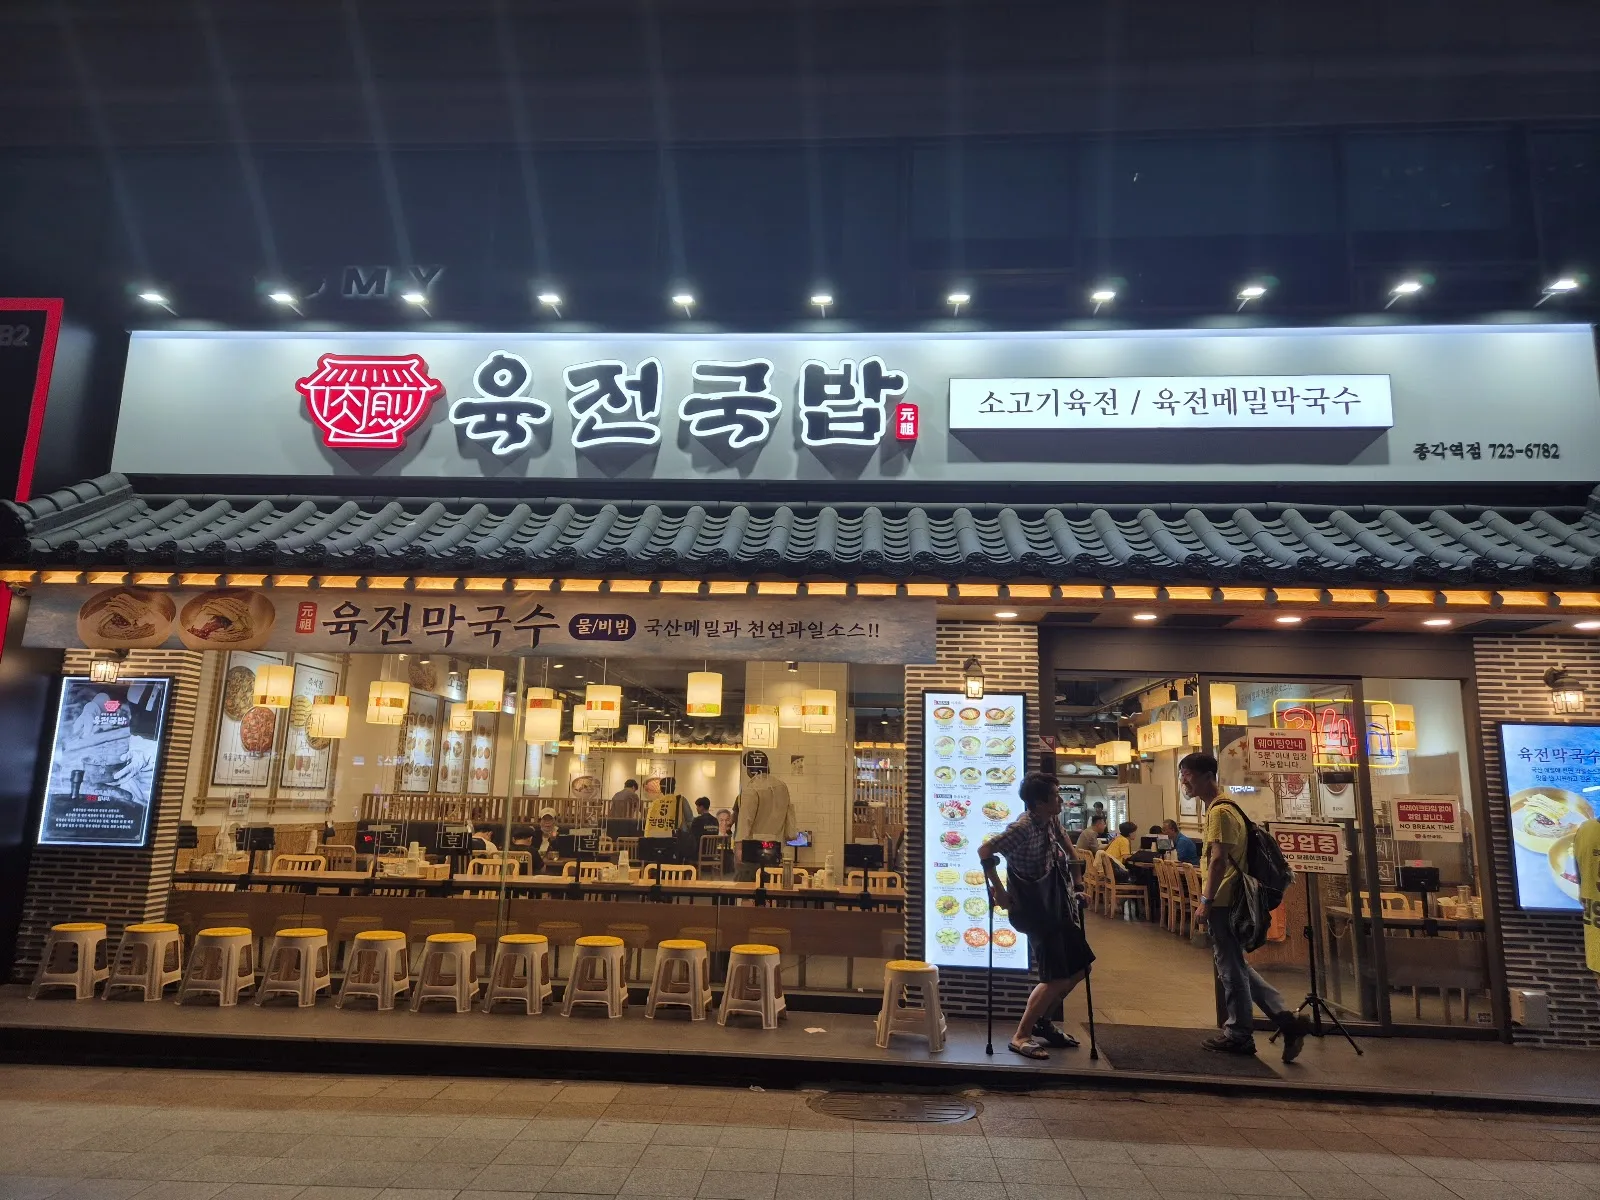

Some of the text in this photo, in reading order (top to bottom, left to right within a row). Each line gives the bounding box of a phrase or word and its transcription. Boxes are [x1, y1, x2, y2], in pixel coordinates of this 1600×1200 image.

[450, 350, 907, 454] 육전국밥
[977, 388, 1120, 417] 소고기육전
[1152, 386, 1363, 417] 육전메밀막국수
[898, 407, 916, 437] 元祖
[1413, 442, 1561, 461] 종각역점 723-6782
[299, 604, 314, 631] 元祖
[321, 601, 561, 648] 육전막국수
[575, 617, 630, 636] 물/비빔
[643, 618, 881, 640] 국산메밀과 천연과일소스!!
[1257, 738, 1303, 750] 웨이팅안내
[1292, 752, 1307, 761] 입장
[1518, 746, 1600, 764] 육전막국수
[1412, 823, 1436, 831] BREAK
[1277, 833, 1336, 853] 영업중
